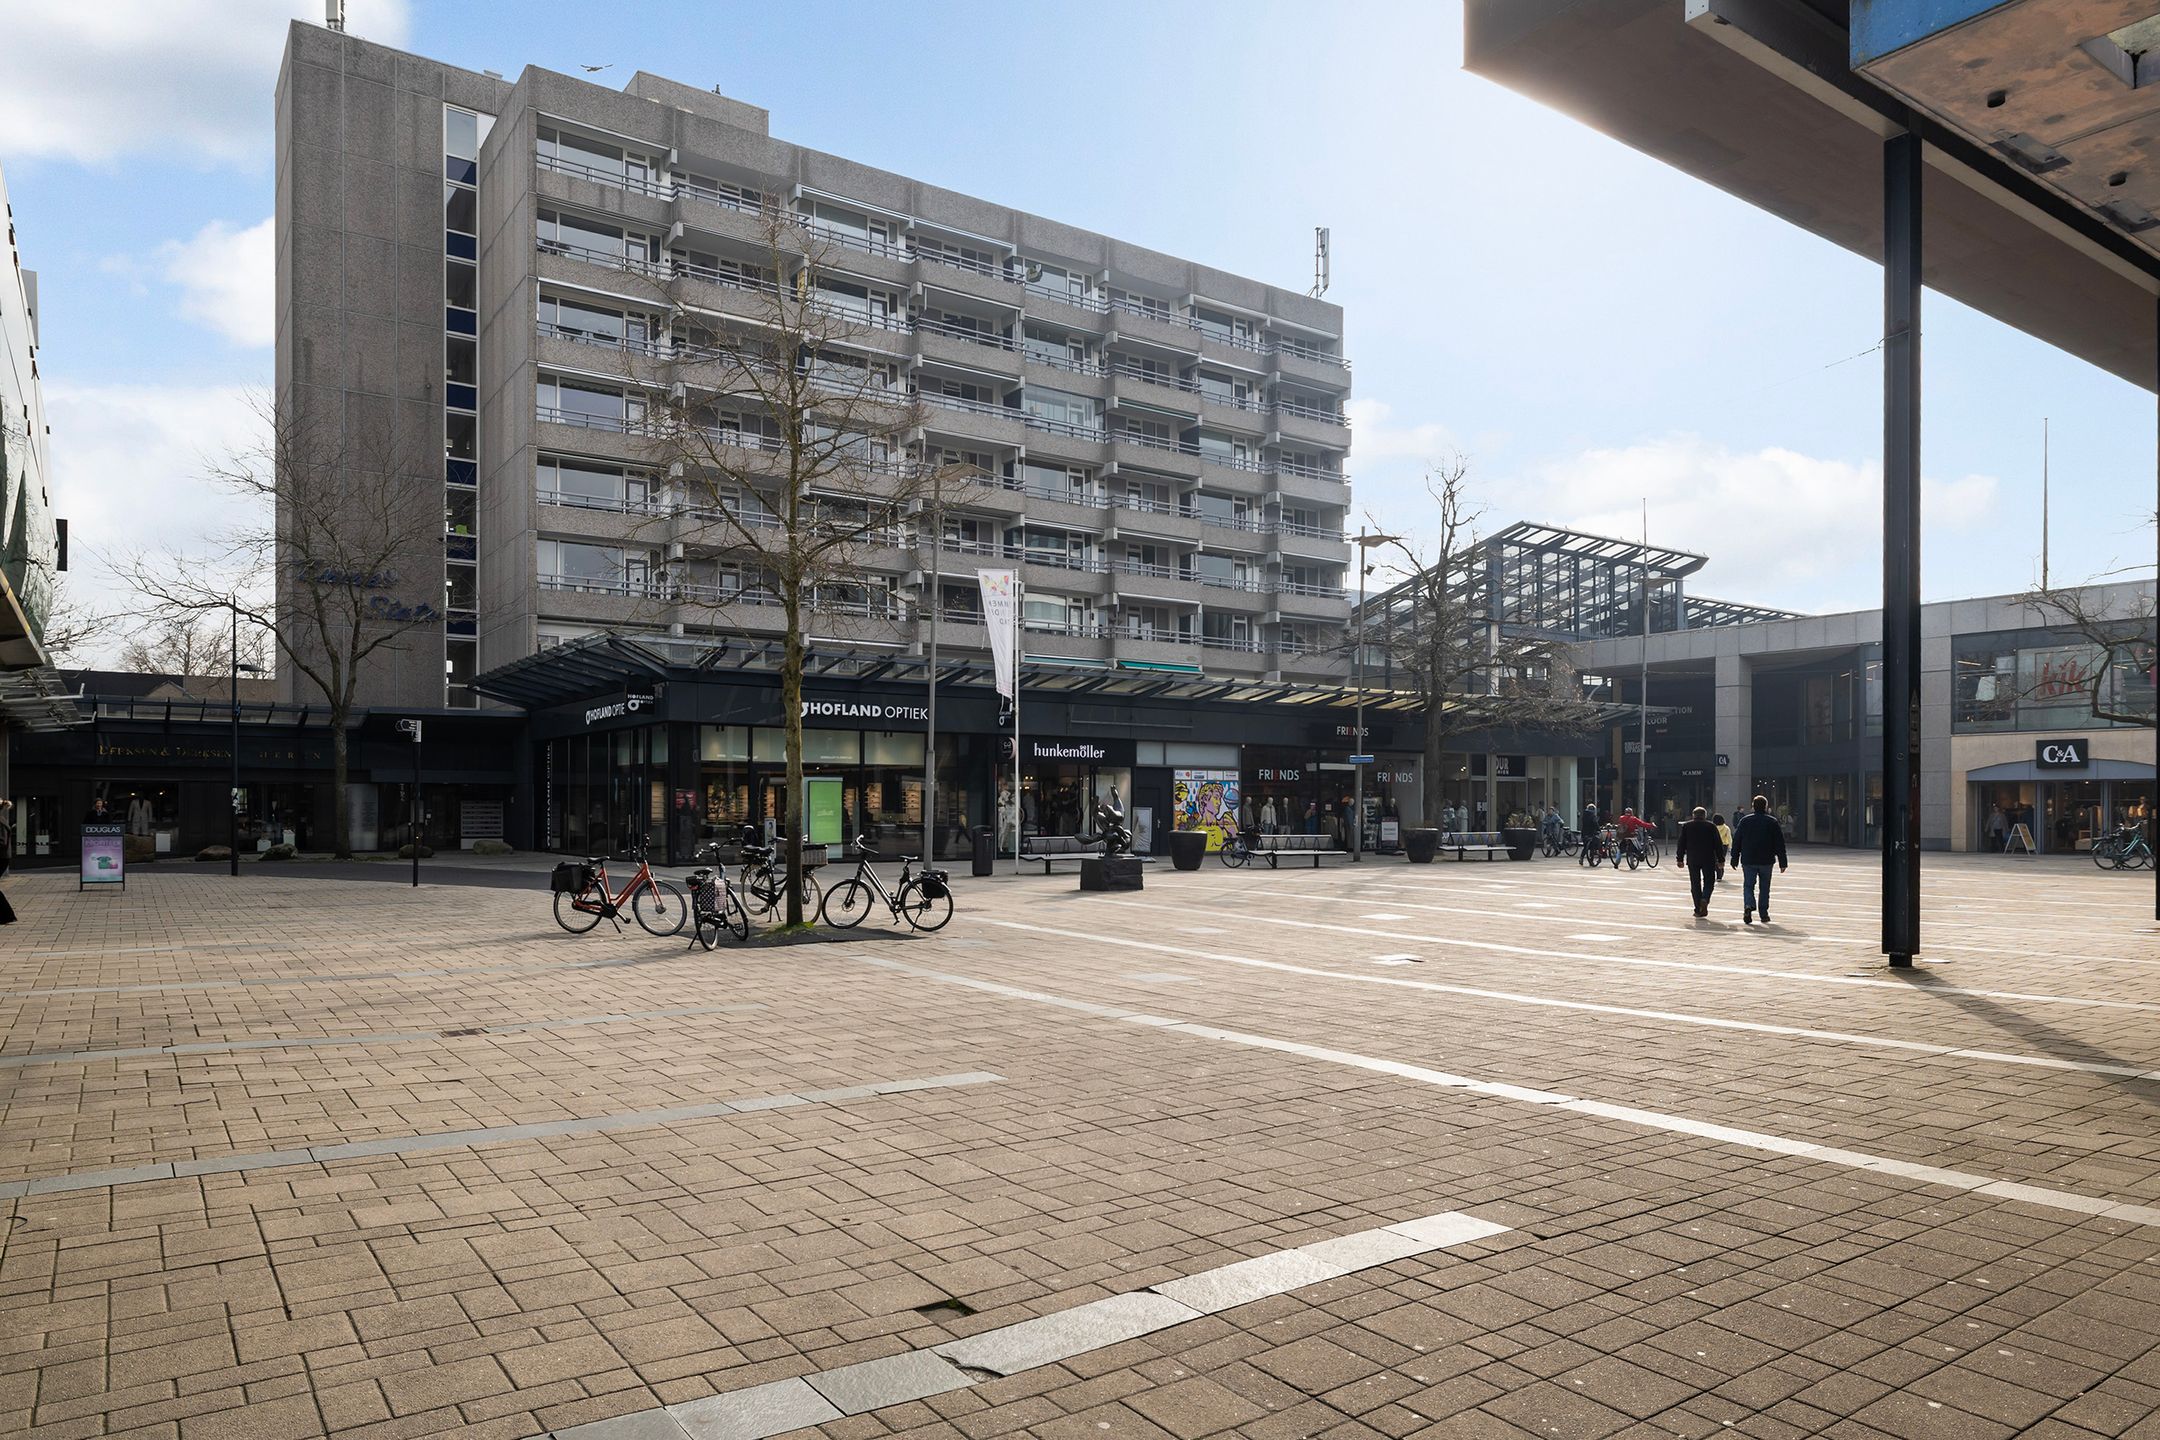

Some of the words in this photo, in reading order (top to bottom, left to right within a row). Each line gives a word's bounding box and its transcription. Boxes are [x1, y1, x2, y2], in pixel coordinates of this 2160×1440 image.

[590, 705, 611, 721] HOFLAND
[611, 702, 625, 717] OPTIE
[810, 702, 882, 717] HOFLAND
[884, 706, 928, 720] OPTIEK
[1034, 742, 1105, 759] hunkemöller
[2042, 744, 2081, 763] C&A
